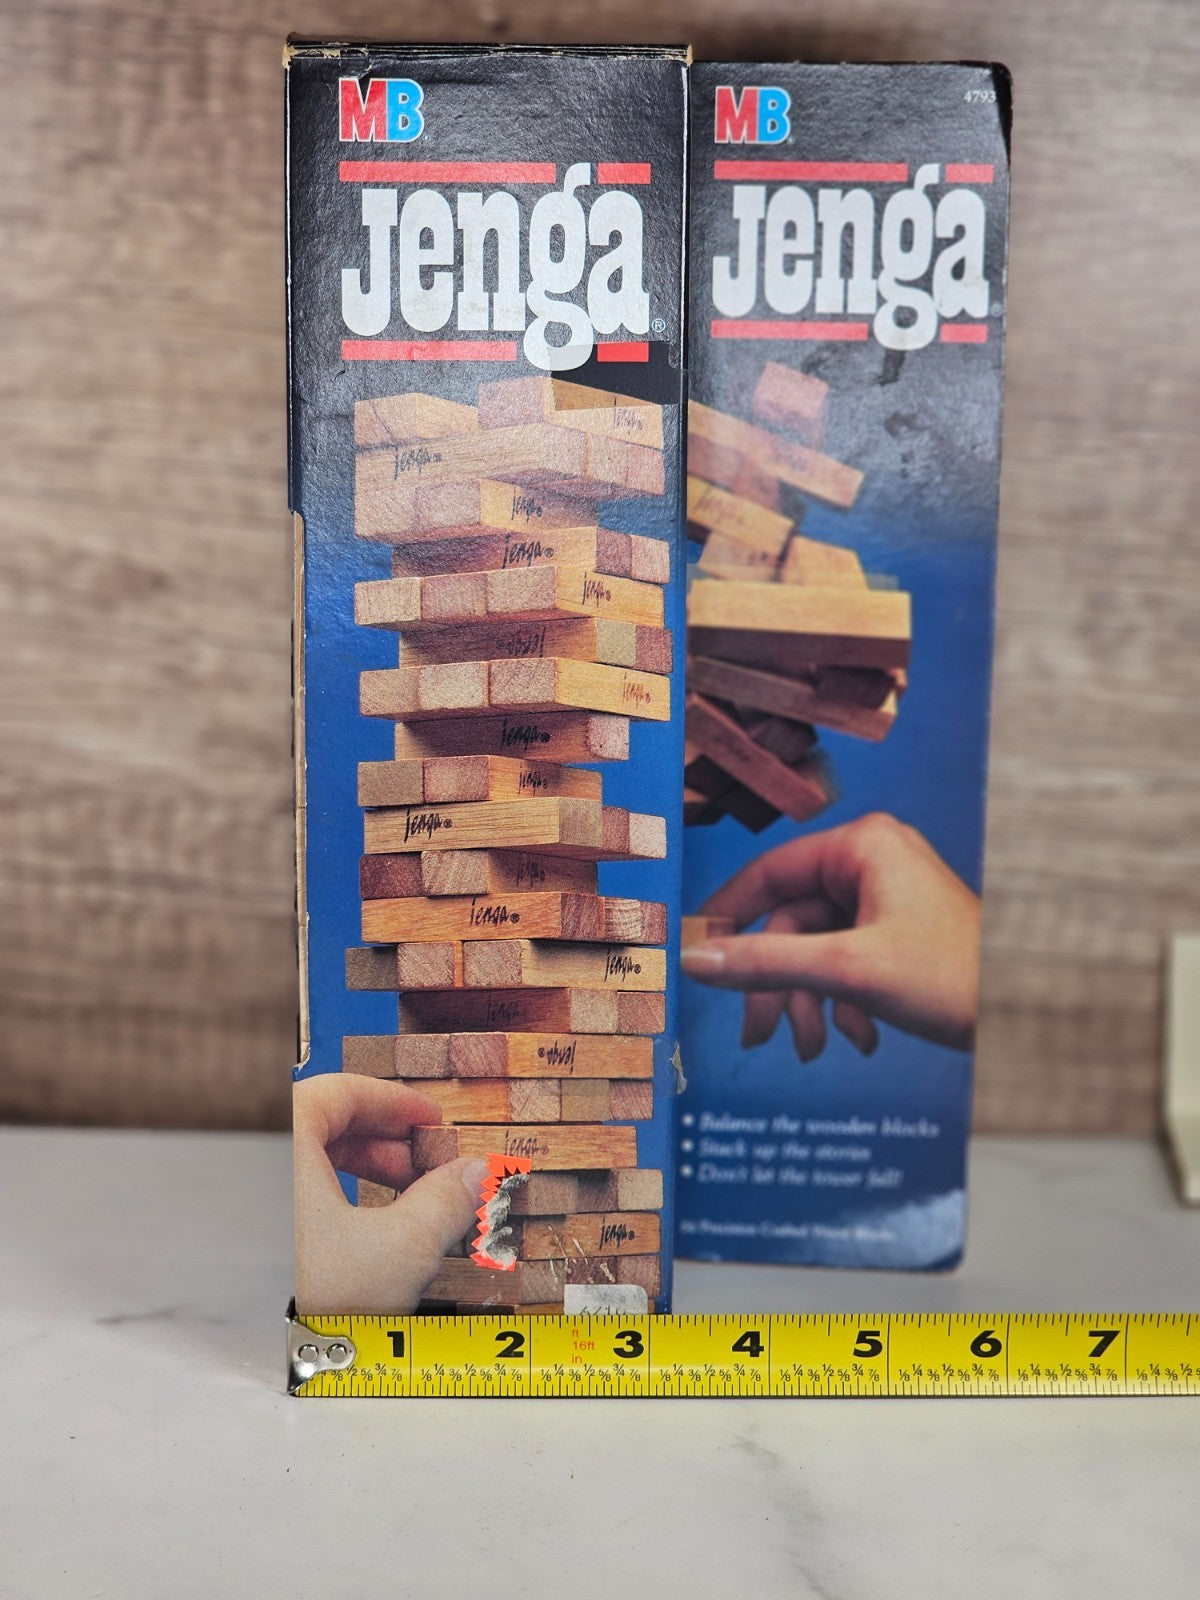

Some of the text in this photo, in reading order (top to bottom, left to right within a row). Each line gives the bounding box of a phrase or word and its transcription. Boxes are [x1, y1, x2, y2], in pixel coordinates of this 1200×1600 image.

[339, 77, 425, 143] MB
[964, 90, 997, 104] 4793
[714, 85, 791, 144] MB
[341, 162, 650, 371] Jenga
[712, 163, 990, 350] Jenga
[387, 1330, 1121, 1358] 1 2 3 4 5 6 7
[571, 1328, 579, 1338] ft
[572, 1340, 596, 1351] 16ft
[571, 1354, 583, 1364] in
